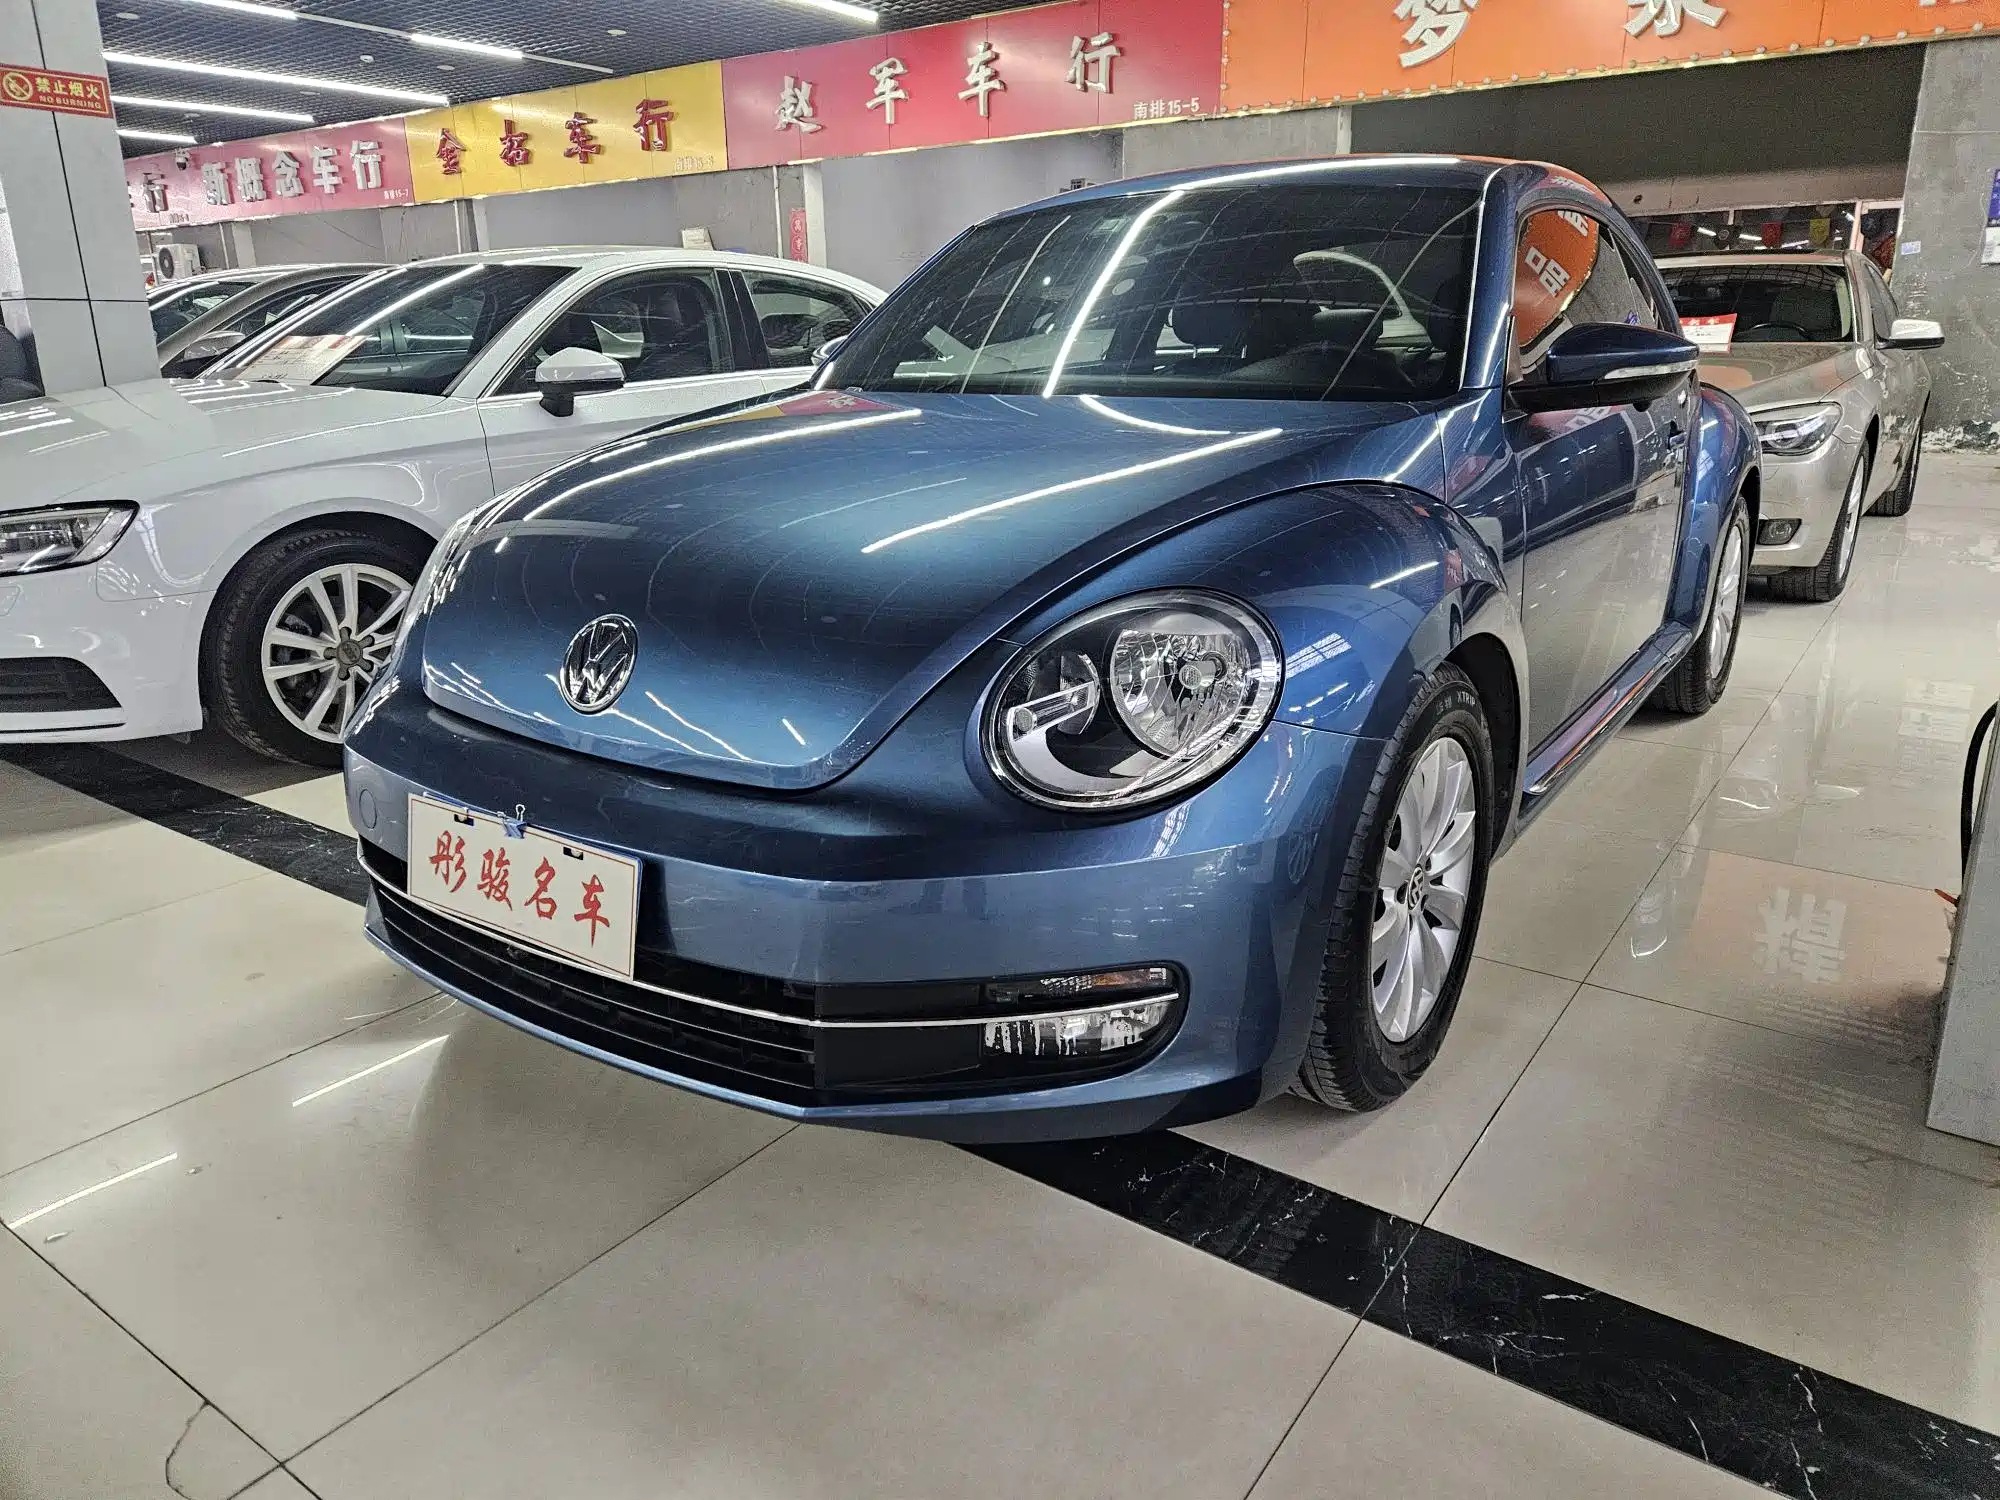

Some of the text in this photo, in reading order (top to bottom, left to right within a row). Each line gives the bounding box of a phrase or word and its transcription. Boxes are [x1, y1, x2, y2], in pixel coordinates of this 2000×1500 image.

[35, 76, 101, 100] 禁止烟火
[39, 95, 101, 109] NO BURNING
[775, 32, 1121, 134] 赵军车行
[1133, 97, 1200, 120] 南排15-5
[200, 140, 383, 206] 新概念车行
[428, 830, 610, 948] 彤骏名车
